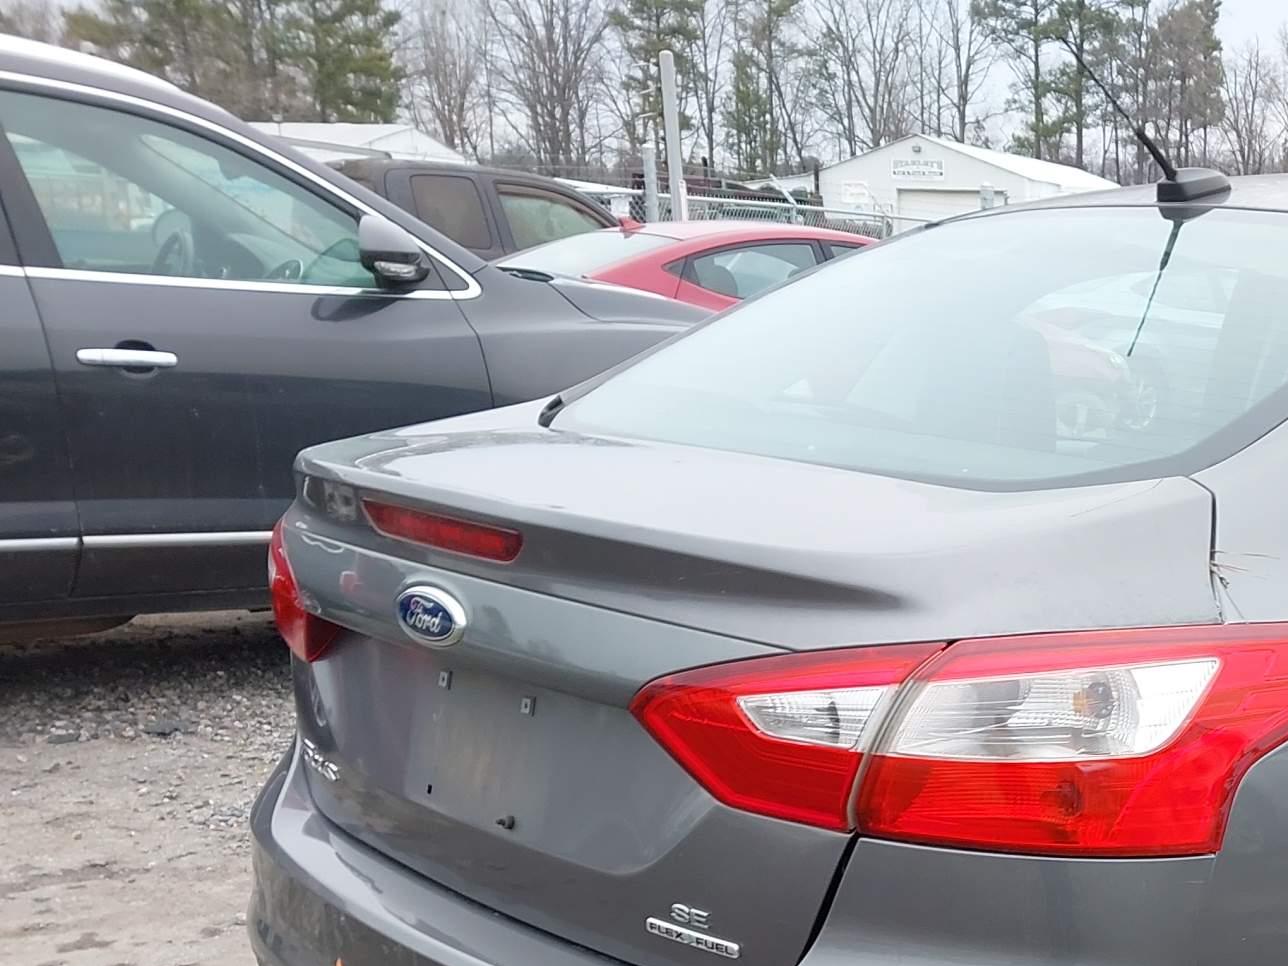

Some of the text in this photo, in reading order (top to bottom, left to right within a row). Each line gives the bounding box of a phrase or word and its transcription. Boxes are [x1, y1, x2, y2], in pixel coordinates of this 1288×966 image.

[406, 596, 443, 633] Ford
[670, 903, 711, 929] SE
[649, 922, 736, 956] FLEX FUEL
